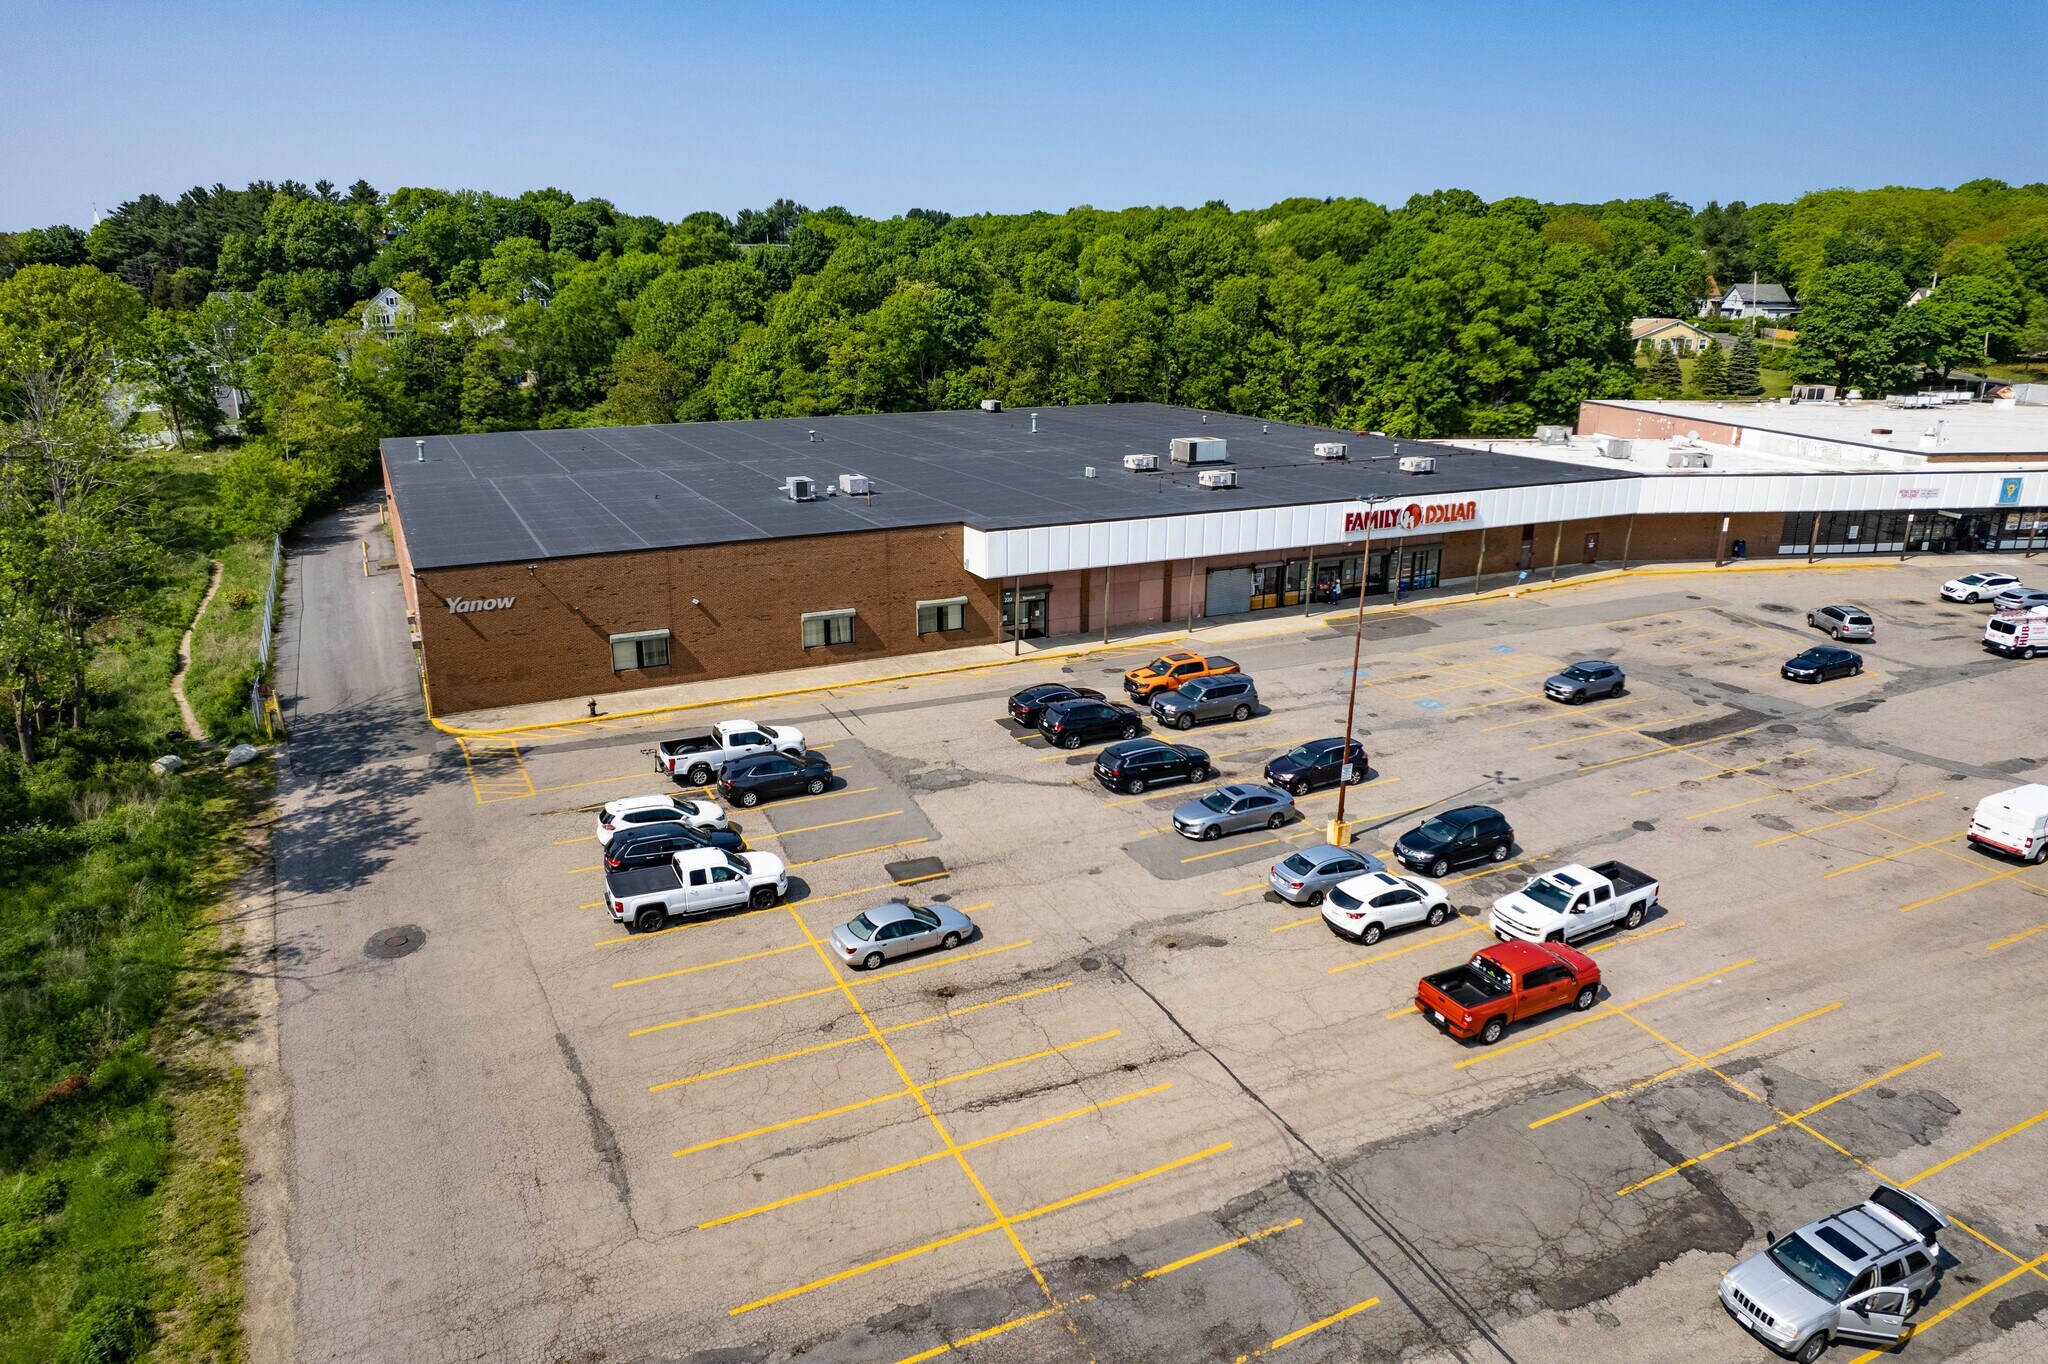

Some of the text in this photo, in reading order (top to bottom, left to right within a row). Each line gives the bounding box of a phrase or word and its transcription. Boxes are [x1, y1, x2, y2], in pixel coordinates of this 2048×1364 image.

[1345, 501, 1476, 531] FAMILY DOLLAR
[445, 596, 515, 613] Yanow
[2018, 626, 2030, 646] HUB
